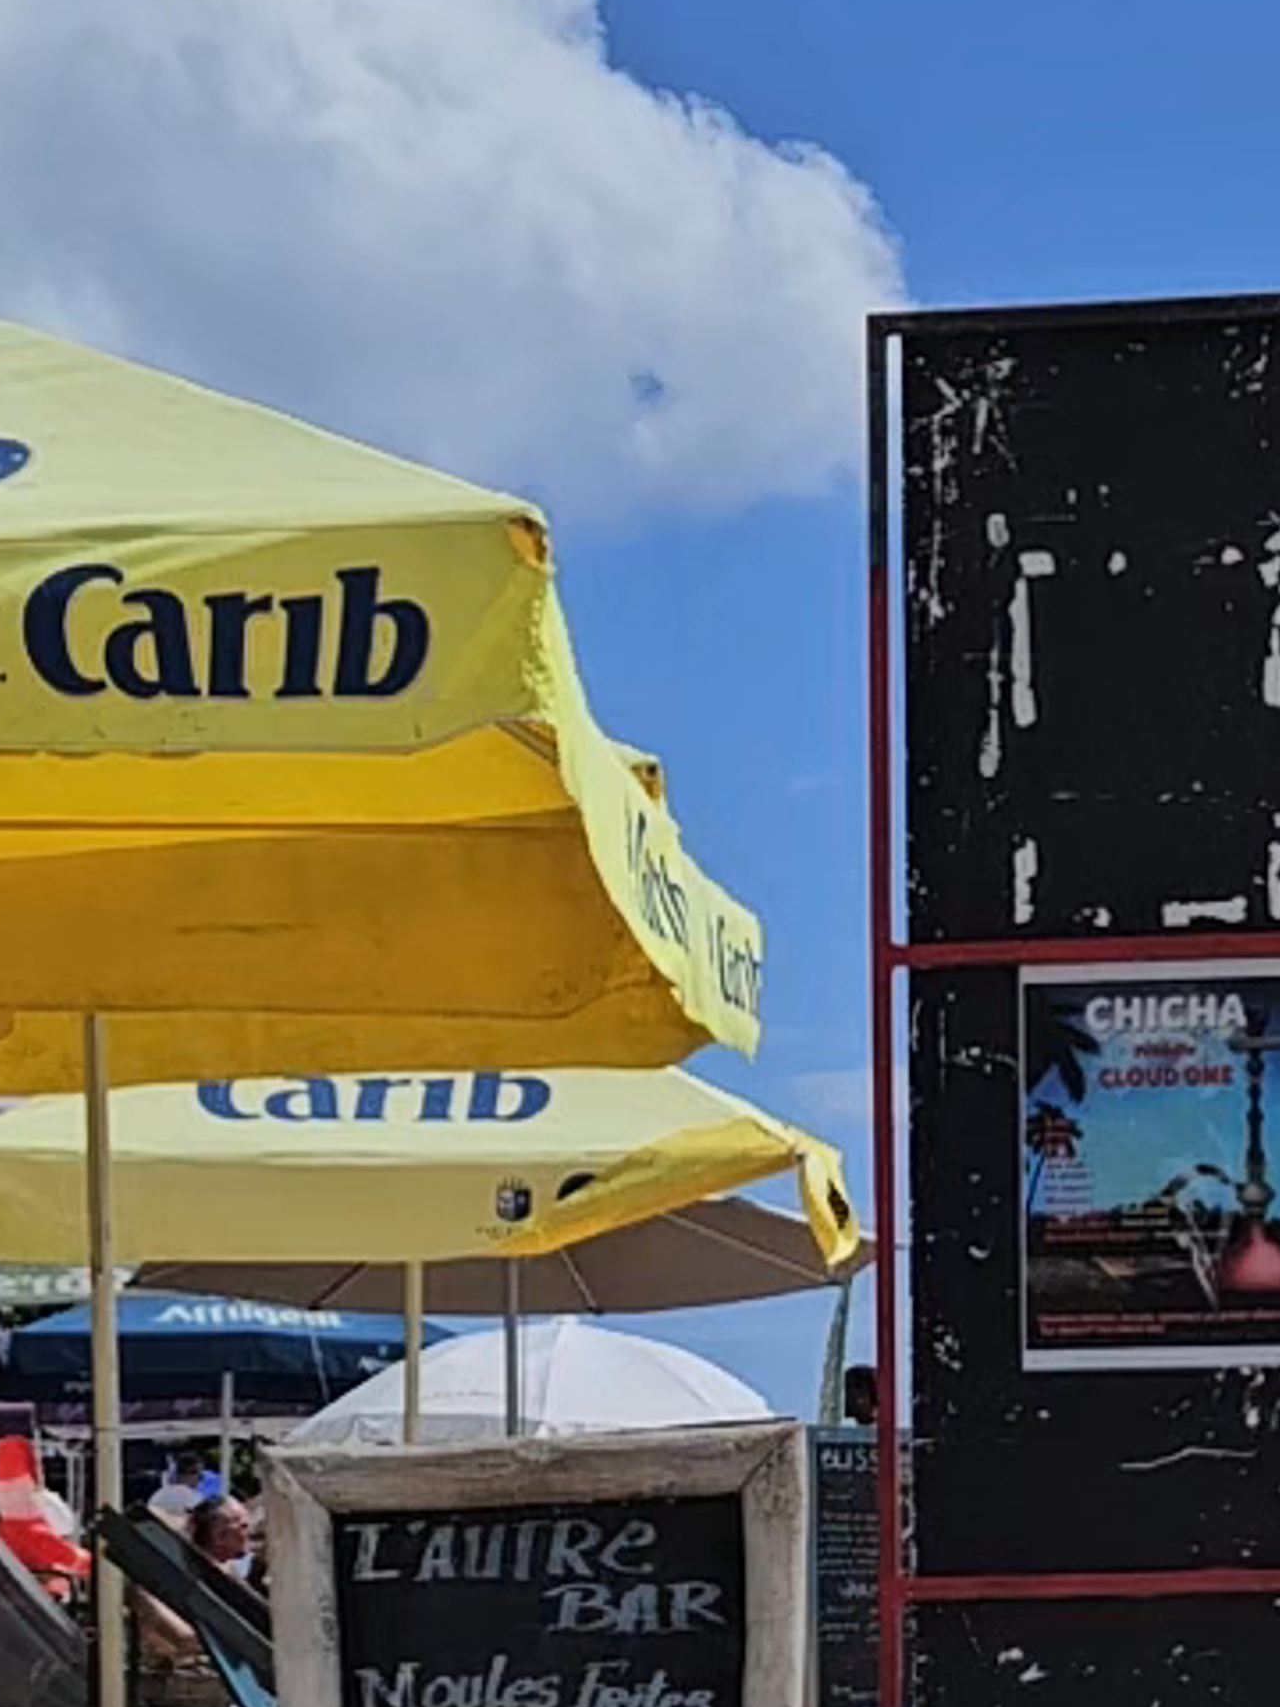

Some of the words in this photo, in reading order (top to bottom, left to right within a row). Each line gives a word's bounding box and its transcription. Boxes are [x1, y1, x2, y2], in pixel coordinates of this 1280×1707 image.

[23, 563, 430, 699] Carib
[1085, 993, 1248, 1029] CHICHA
[1100, 1066, 1179, 1087] CLOUD
[1185, 1064, 1234, 1086] ONE
[543, 1581, 726, 1633] BAR
